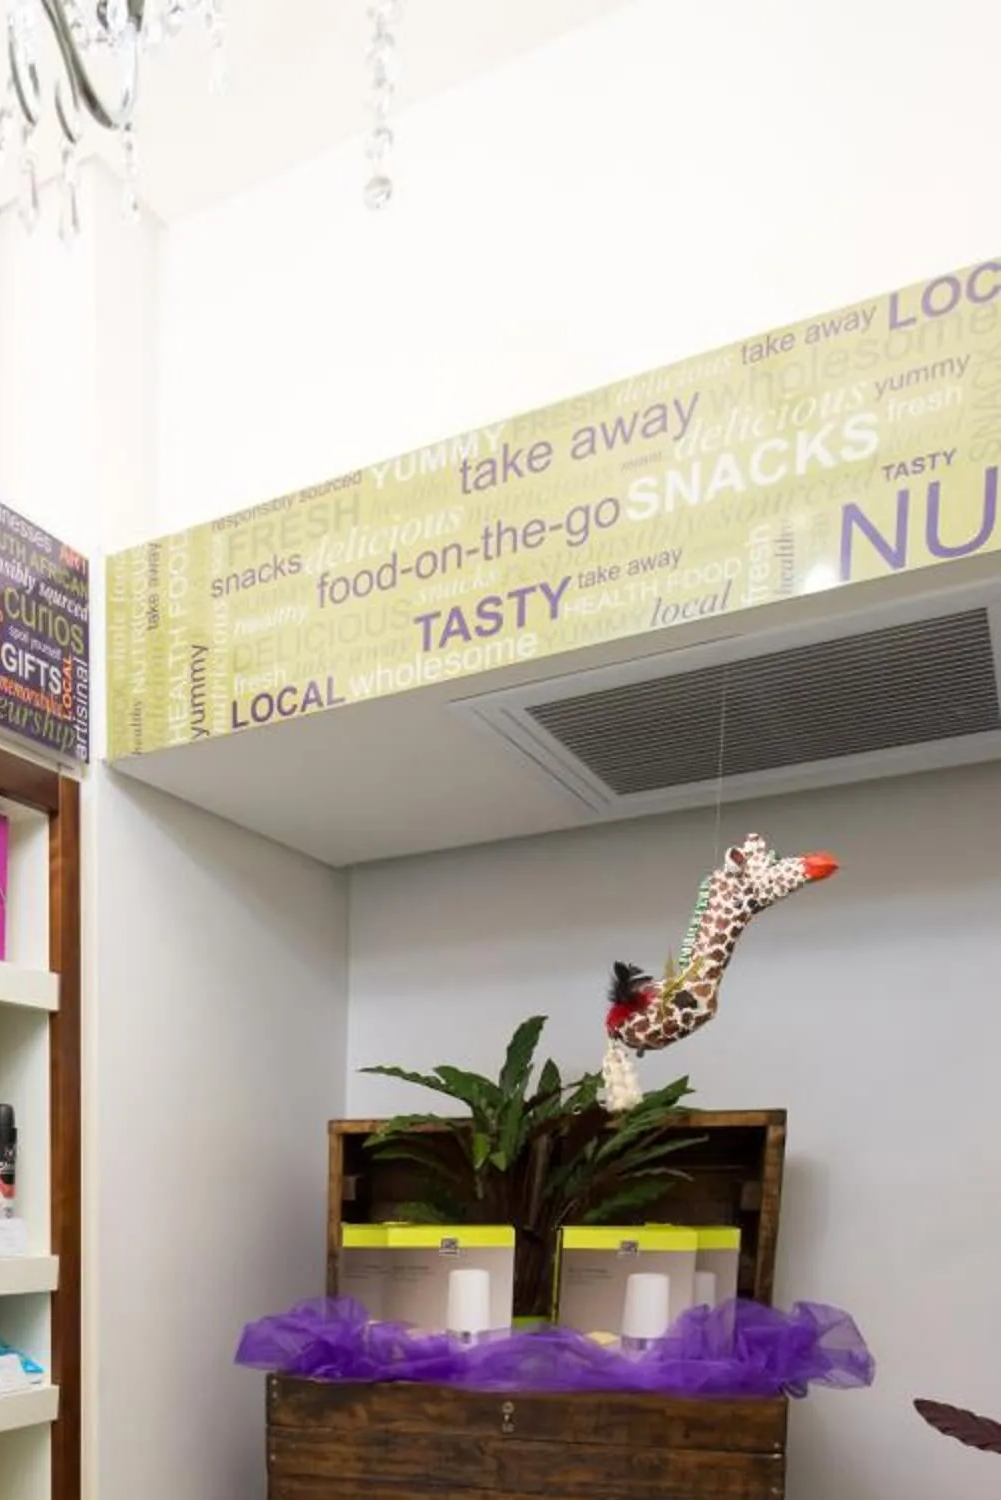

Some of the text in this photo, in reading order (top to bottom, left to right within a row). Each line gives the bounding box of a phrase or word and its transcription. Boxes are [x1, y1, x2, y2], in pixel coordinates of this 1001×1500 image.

[889, 261, 1001, 331] LOC
[710, 303, 998, 408] wholesome
[740, 306, 877, 366] take away
[873, 353, 972, 401] yummy
[886, 385, 965, 424] fresh
[371, 420, 507, 489] YUMMY
[458, 440, 554, 495] take
[570, 392, 699, 461] away
[673, 379, 871, 462] delicious
[625, 412, 879, 522] SNACKS
[882, 448, 957, 483] TASTY
[228, 493, 361, 567] FRESH
[301, 505, 462, 575] delicious
[317, 497, 621, 608] food-on-the-go
[839, 465, 999, 581] NU
[30, 553, 88, 598] AFRICAN
[39, 580, 88, 622] sourced
[210, 553, 303, 600] snacks
[564, 577, 658, 618] HEALTH
[577, 547, 684, 590] take away
[650, 577, 733, 627] local
[3, 586, 85, 656] curios
[146, 592, 161, 632] take
[232, 600, 411, 674] DELICIOUS
[414, 576, 572, 652] TASTY
[0, 641, 63, 695] GIFTS
[62, 653, 74, 720] LOCAL
[189, 643, 212, 741] yummy
[349, 632, 539, 700] wholesome
[75, 655, 89, 760] artisinal
[231, 676, 346, 730] LOCAL
